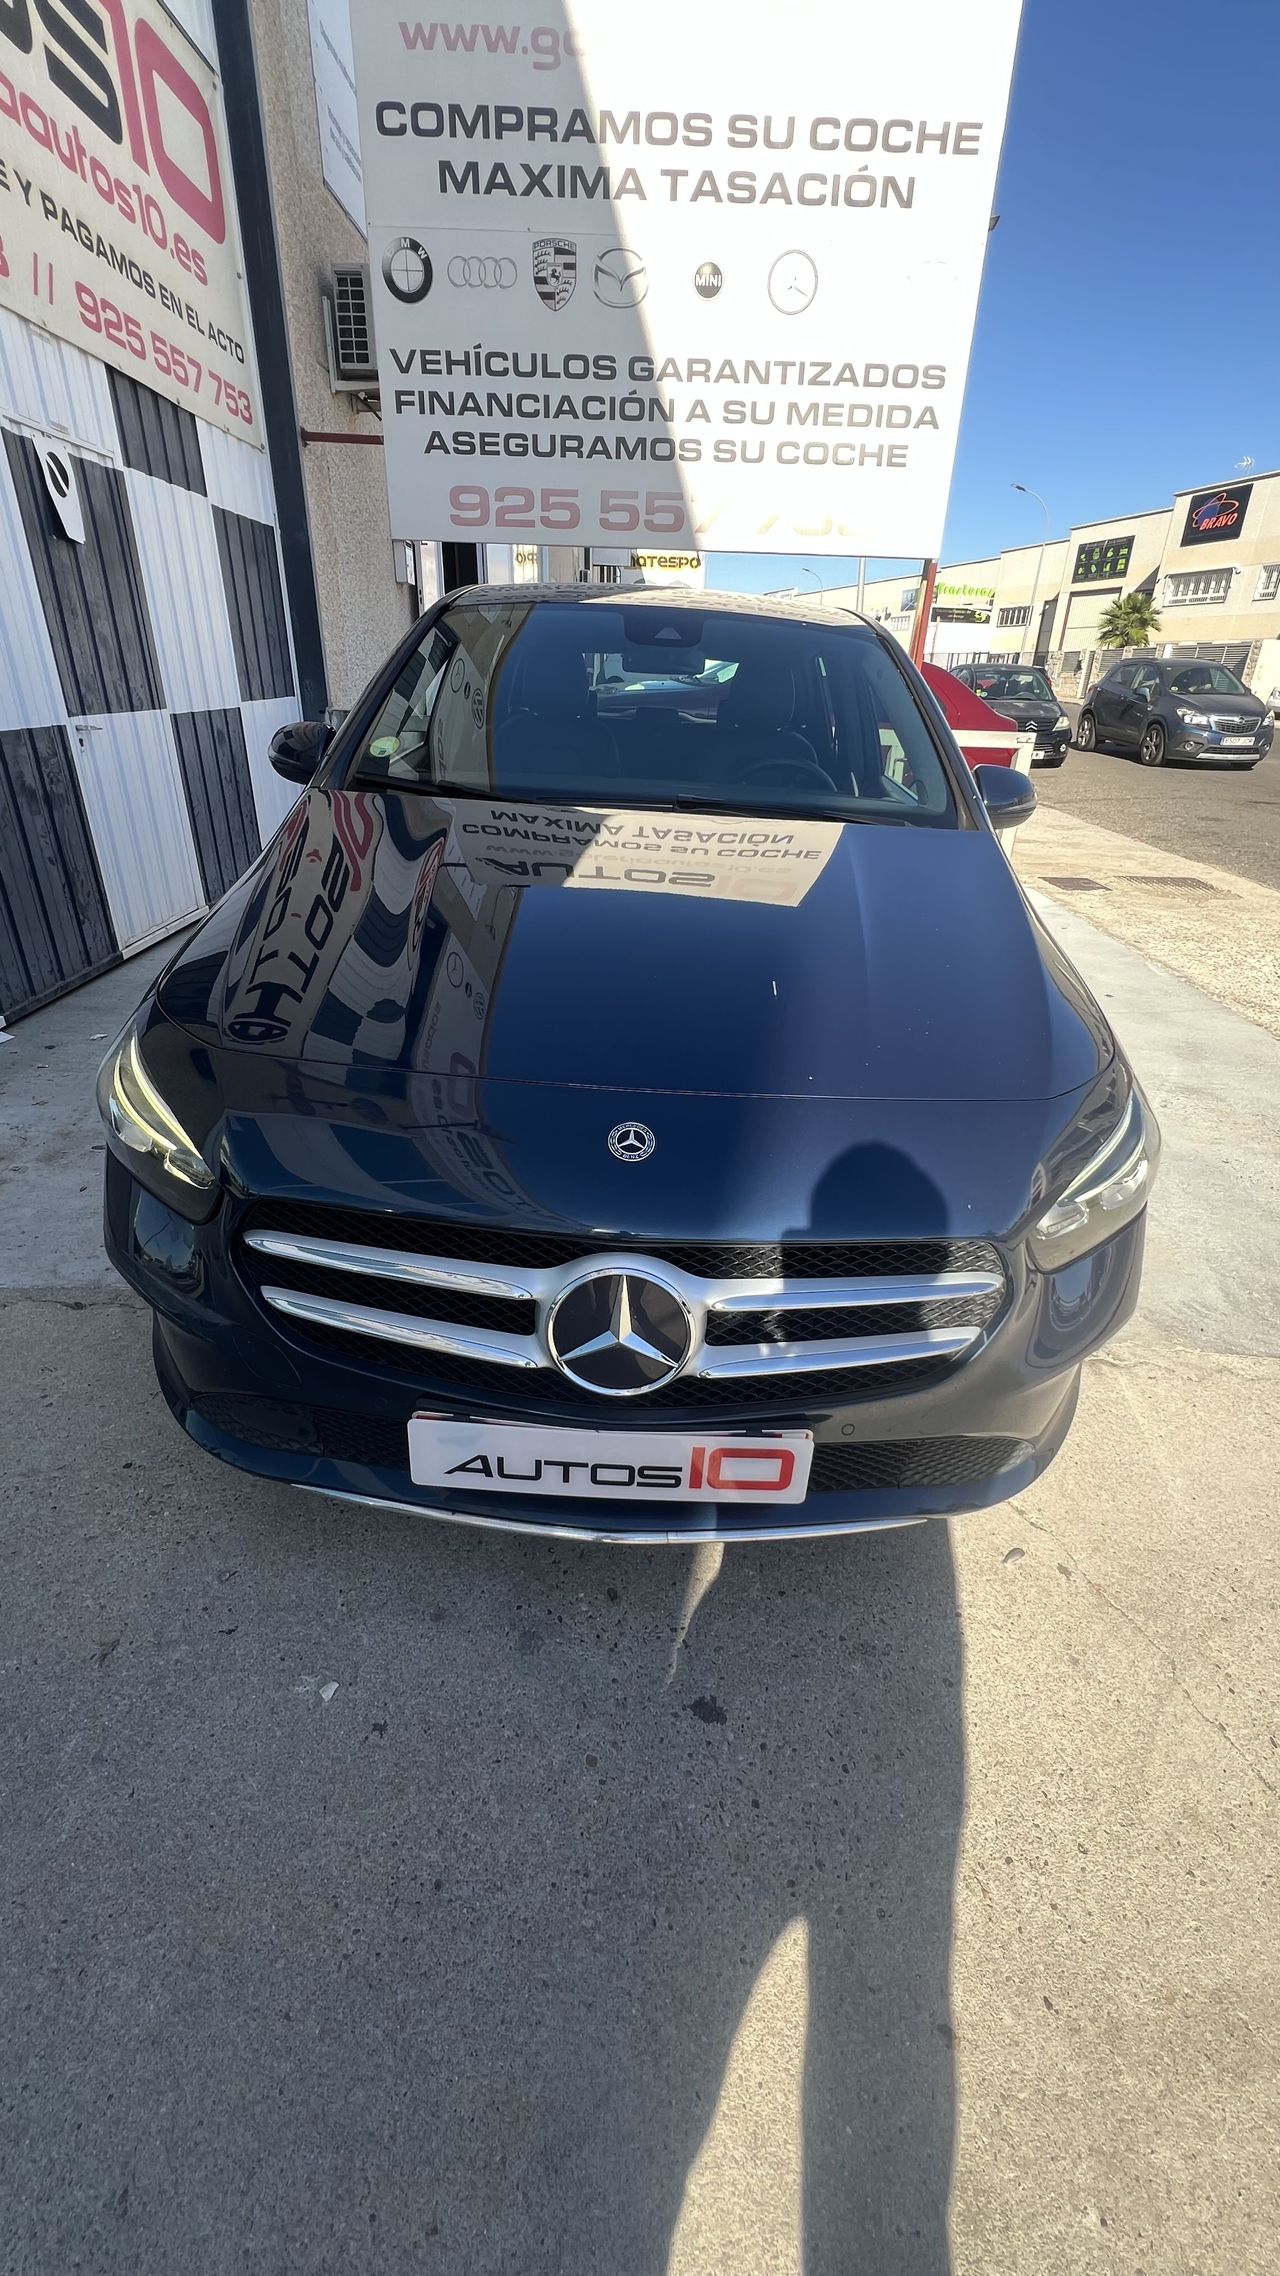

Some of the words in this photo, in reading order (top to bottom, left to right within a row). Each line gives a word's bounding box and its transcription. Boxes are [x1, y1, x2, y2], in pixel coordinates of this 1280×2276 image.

[375, 100, 712, 148] COMPRAMOS
[727, 114, 795, 150] SU
[809, 117, 983, 155] COCHE
[437, 159, 647, 202] MAXIMA
[660, 164, 915, 209] TASACIÓN
[13, 168, 32, 208] Y
[39, 189, 156, 300] PAGAMOS
[158, 282, 184, 320] EN
[185, 304, 206, 336] EL
[208, 321, 245, 364] ACTO
[695, 272, 723, 288] MINI
[75, 280, 147, 361] 925
[150, 330, 203, 394] 557
[208, 368, 253, 426] 753
[389, 343, 618, 381] VEHÍCULOS
[626, 354, 946, 389] GARANTIZADOS
[394, 389, 674, 423] FINANCIACIÓN
[685, 399, 712, 423] A
[723, 400, 775, 425] SU
[787, 402, 939, 429] MEDIDA
[424, 430, 702, 463] ASEGURAMOS
[713, 440, 765, 464] SU
[776, 441, 909, 467] COCHE
[449, 485, 580, 530] 925
[1199, 513, 1239, 531] BRAVO
[443, 1446, 795, 1492] AUTOS10
